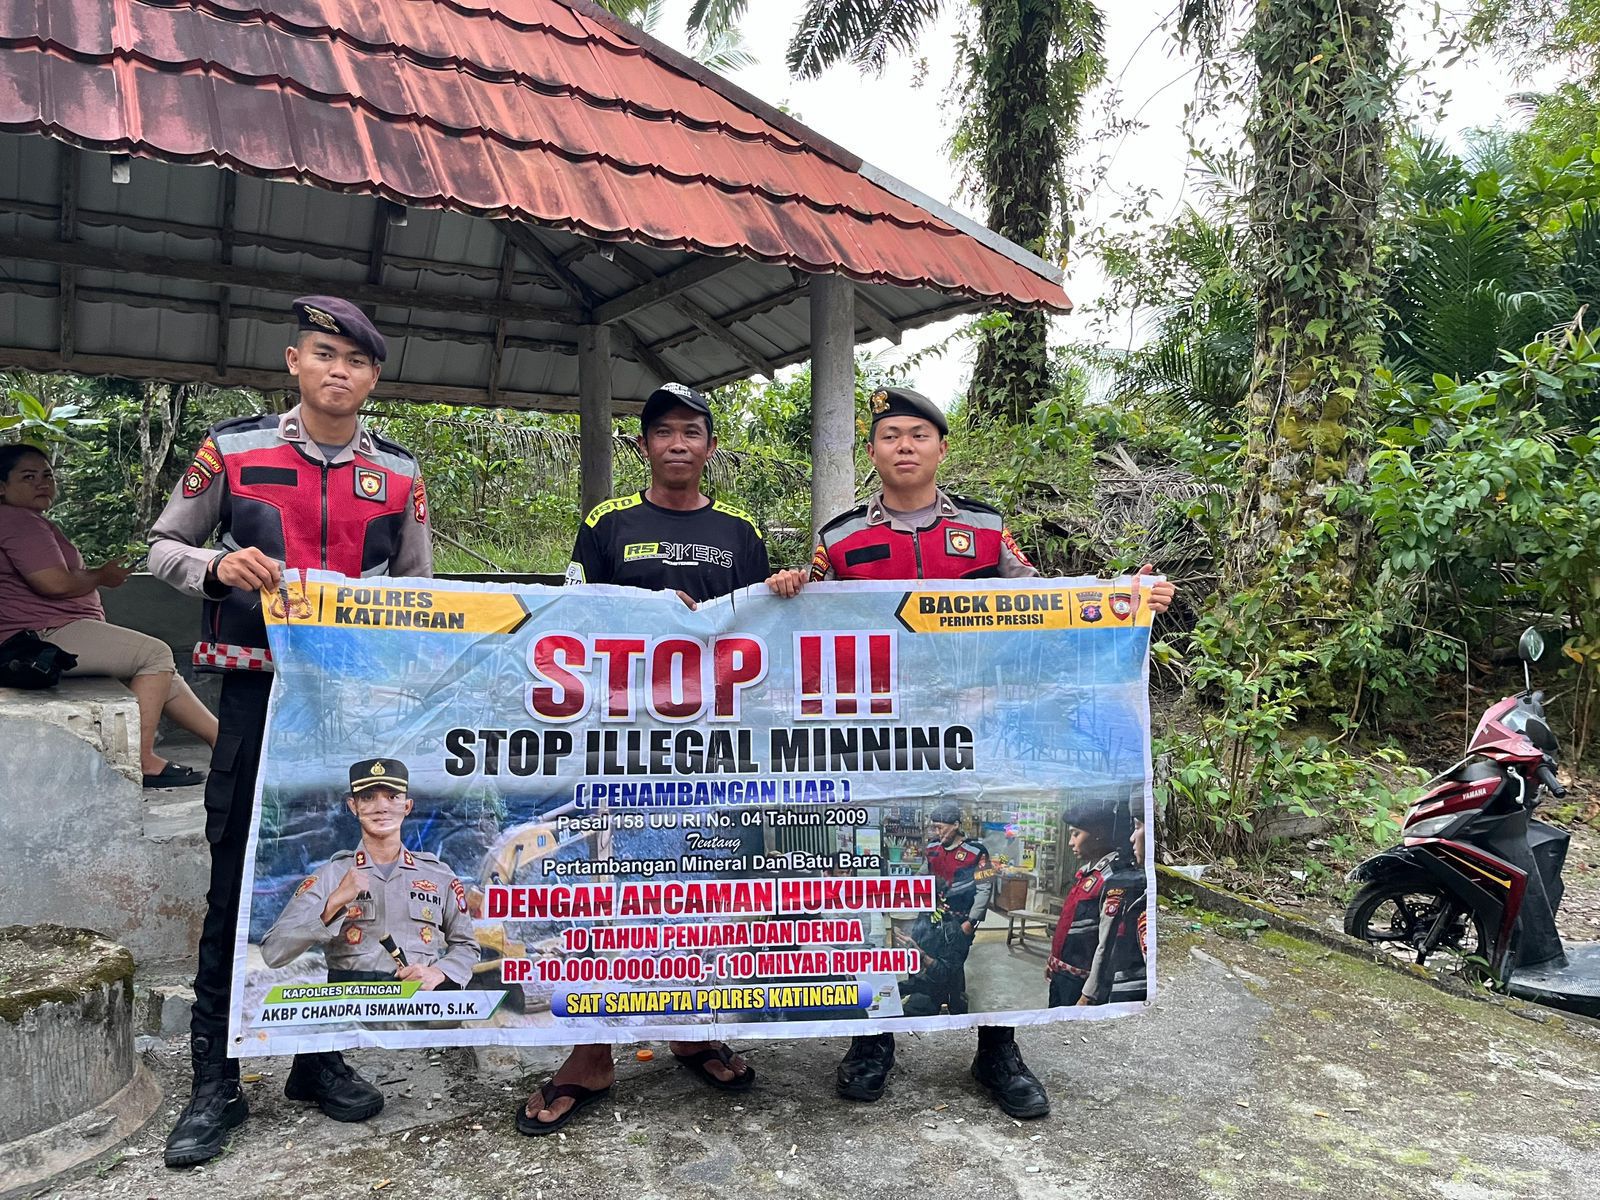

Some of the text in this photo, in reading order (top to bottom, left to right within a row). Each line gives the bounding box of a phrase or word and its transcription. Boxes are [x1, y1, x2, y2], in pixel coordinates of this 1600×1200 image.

[627, 544, 656, 556] RS
[336, 586, 433, 608] POLRES
[919, 592, 991, 615] BACK
[995, 591, 1064, 612] BONE
[334, 608, 465, 630] KATINGAN
[939, 614, 1044, 627] PERINTIS PRESISI
[529, 632, 894, 721] STOP !!!
[445, 725, 975, 776] STOP ILLEGAL MINNING
[557, 809, 867, 830] Pasal 158 UU RI No. 04 Tahun 2009
[686, 833, 742, 852] Tentang
[542, 852, 880, 876] Pertambangan Mineral Dan Batu Bara
[409, 891, 441, 907] POLRI
[487, 878, 933, 919] DENGAN ANCAMAN HUKUMAN
[562, 919, 863, 951] 10 TAHUN PENJARA DAN DENDA
[502, 959, 533, 982] RP.
[757, 951, 827, 976] MILYAR
[282, 984, 401, 999] KAPOLRES KATINGAN
[566, 985, 859, 1014] SAT SAMAPTA POLRES KATINGAN
[261, 1002, 478, 1022] AKBP CHANDRA ISMAWANTO, S.I.K.
